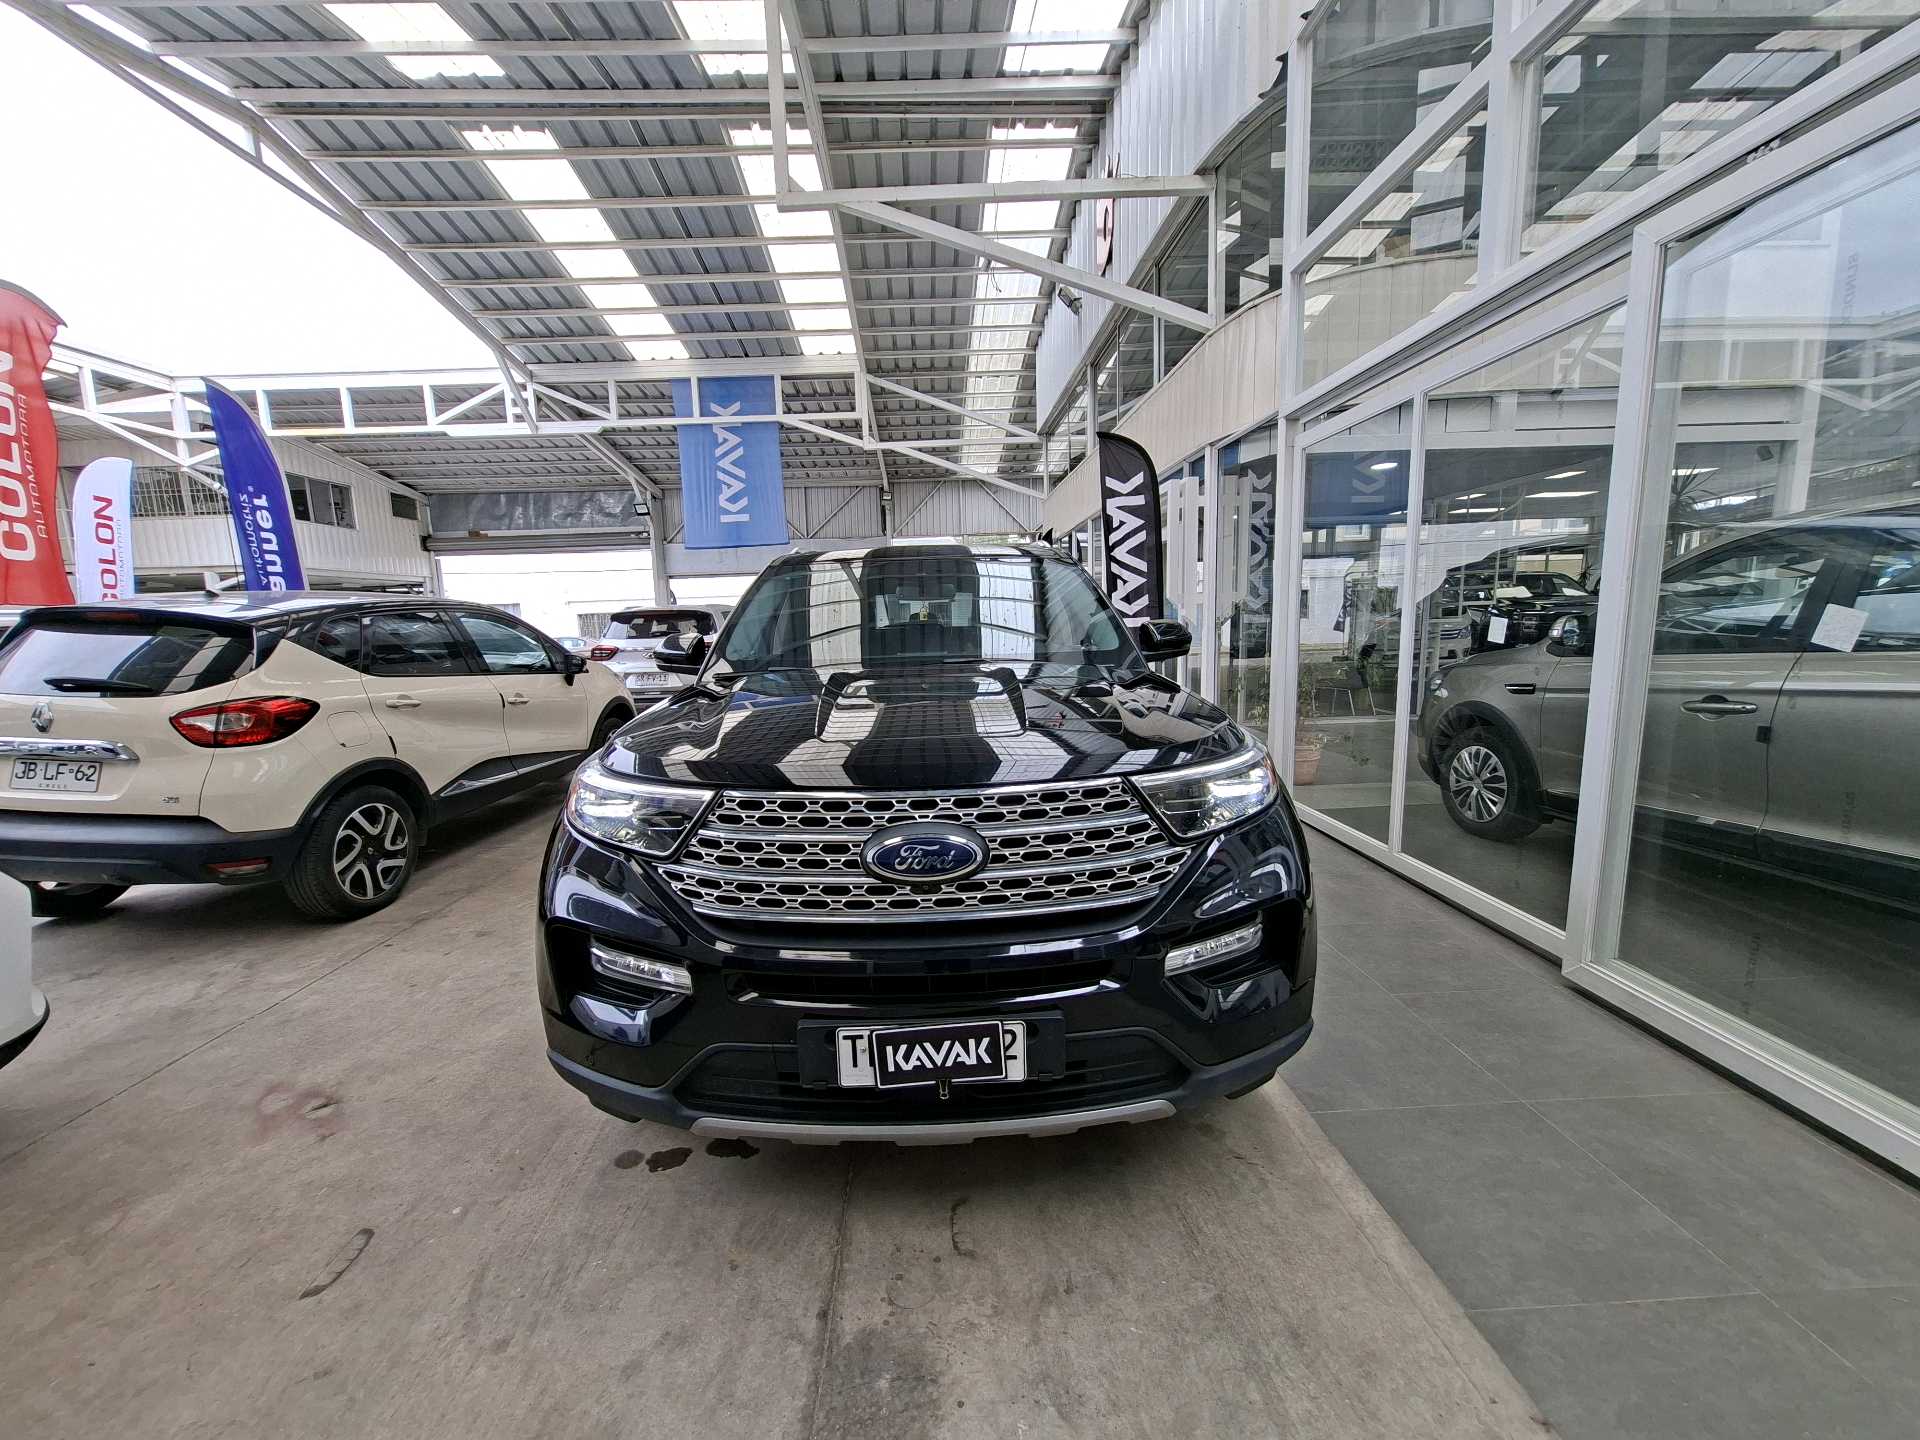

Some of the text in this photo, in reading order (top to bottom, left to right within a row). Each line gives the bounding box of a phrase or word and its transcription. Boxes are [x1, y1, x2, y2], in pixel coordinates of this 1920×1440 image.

[17, 394, 49, 539] AUTOMOTORA
[710, 401, 750, 523] KAVAK
[1105, 471, 1151, 628] KAVAK
[895, 844, 956, 870] Ford
[886, 1037, 993, 1073] KAVAK
